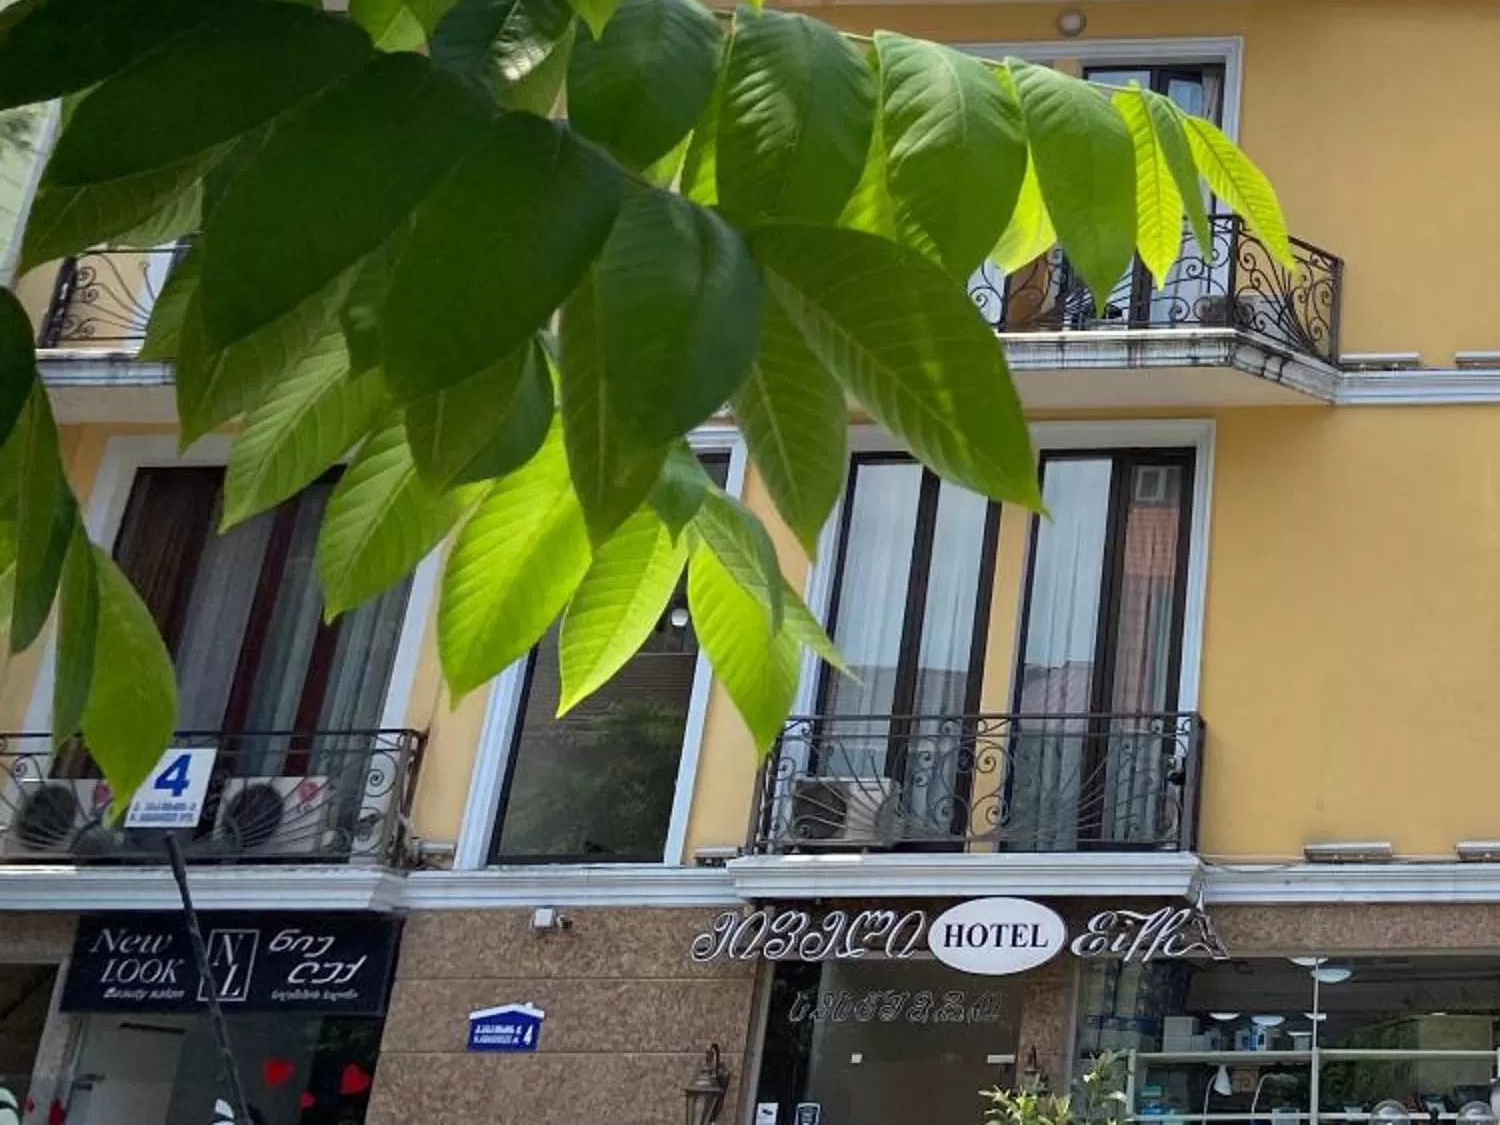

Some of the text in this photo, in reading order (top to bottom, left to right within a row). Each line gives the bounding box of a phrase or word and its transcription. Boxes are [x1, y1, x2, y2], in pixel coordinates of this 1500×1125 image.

[153, 754, 192, 797] 4
[90, 928, 173, 953] New
[268, 928, 335, 958] ნიუ
[943, 923, 1049, 948] HOTEL
[100, 958, 185, 984] LOOK
[288, 955, 368, 984] ლუქ
[523, 1024, 534, 1046] 4
